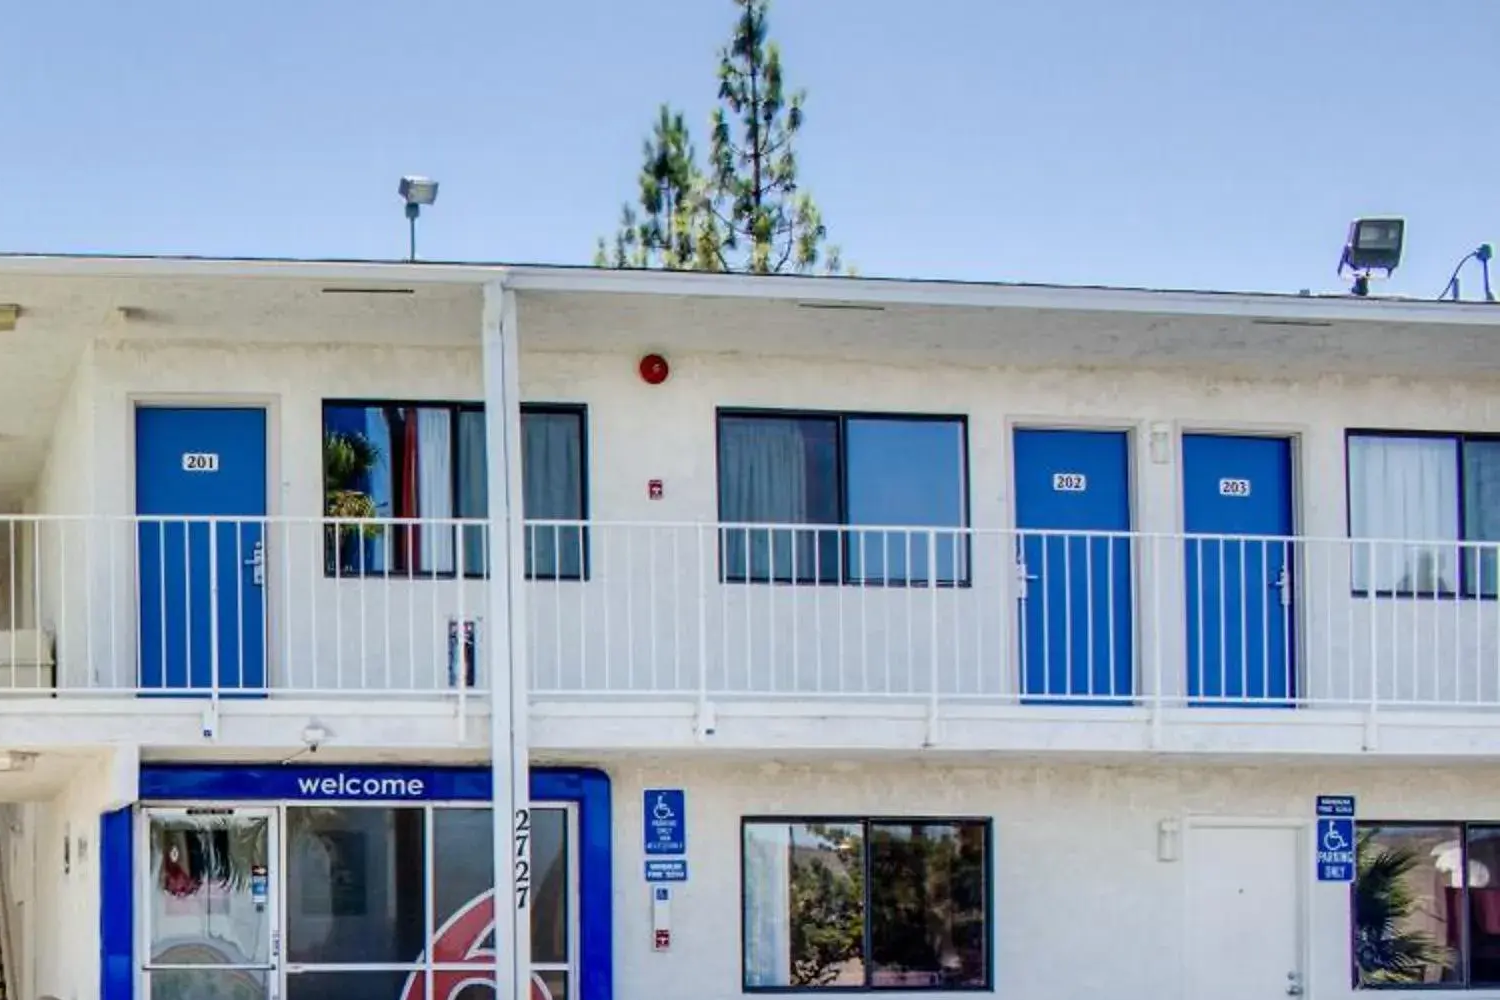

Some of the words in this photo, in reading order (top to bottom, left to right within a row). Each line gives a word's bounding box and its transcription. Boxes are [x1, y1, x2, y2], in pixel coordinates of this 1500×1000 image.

[187, 455, 213, 469] 201
[1057, 475, 1082, 489] 202
[1223, 481, 1247, 495] 203
[298, 772, 425, 795] welcome
[516, 809, 530, 909] 2727
[1318, 852, 1353, 863] PARKING
[1325, 865, 1345, 878] ONLY
